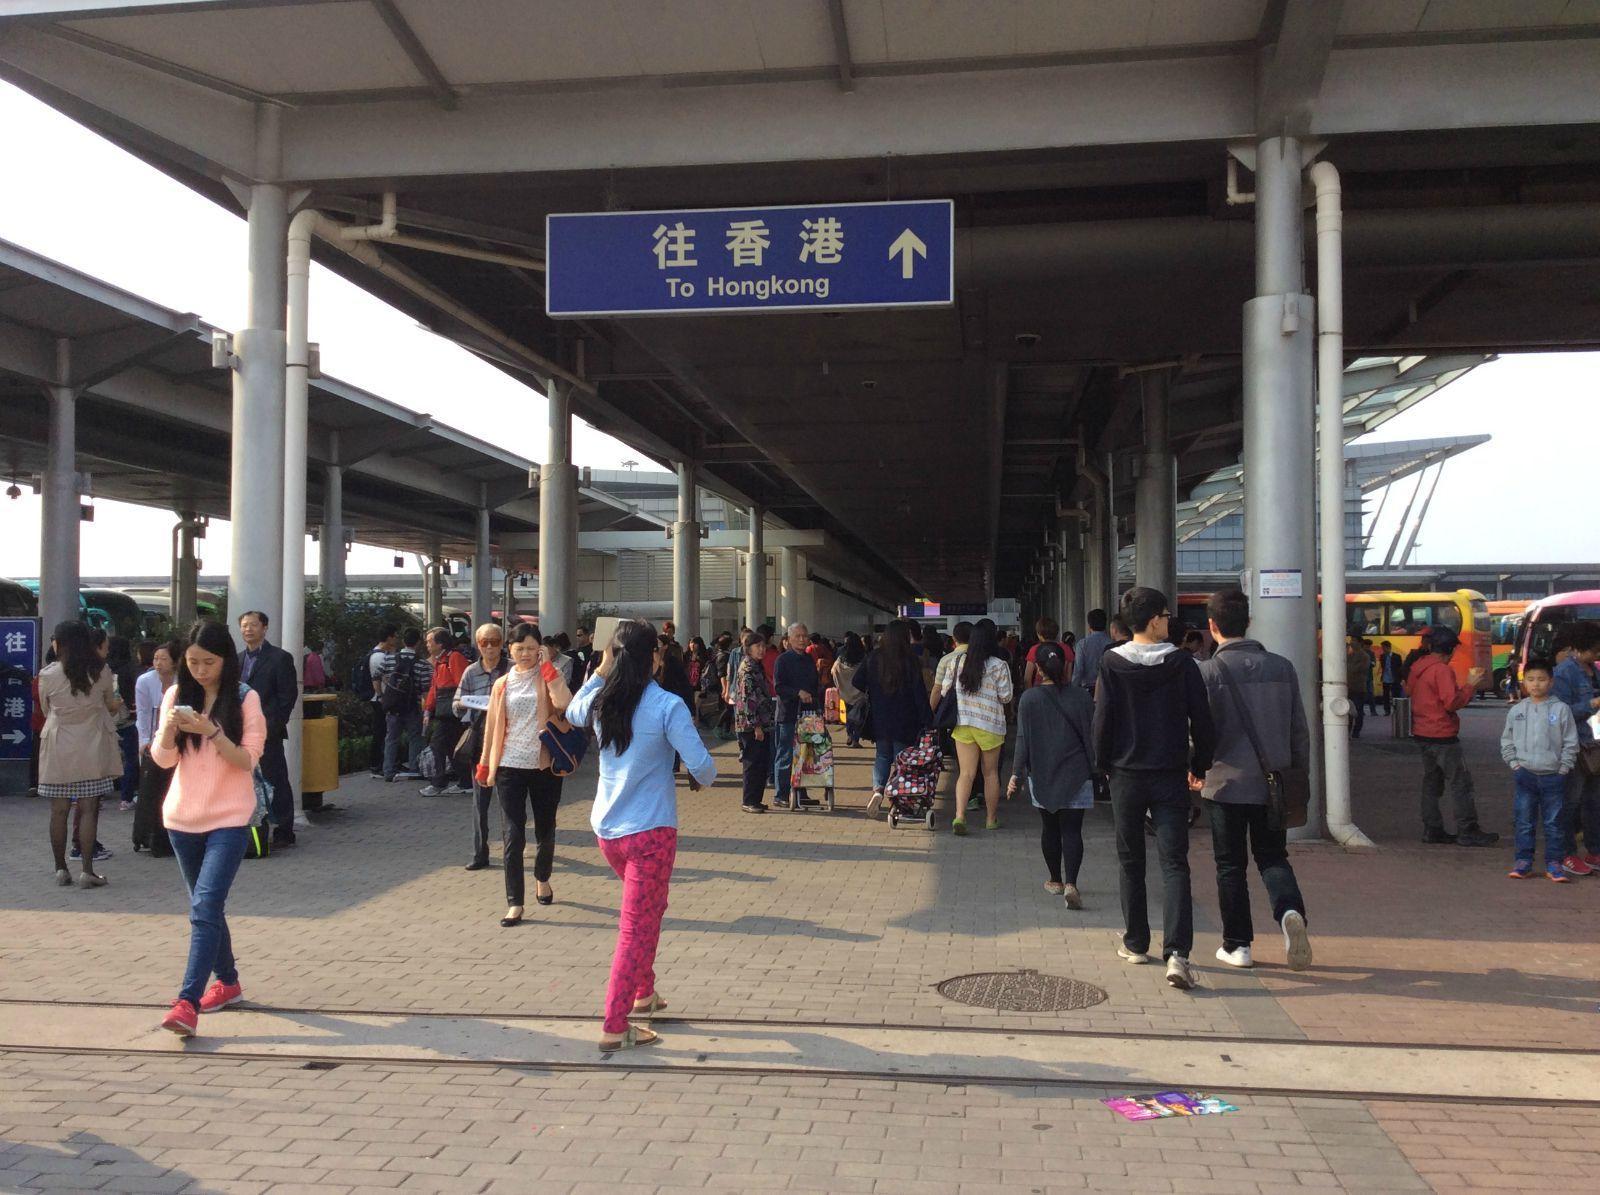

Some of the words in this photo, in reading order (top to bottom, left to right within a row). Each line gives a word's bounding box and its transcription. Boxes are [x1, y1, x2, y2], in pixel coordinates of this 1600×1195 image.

[651, 217, 844, 270] 往香港
[665, 278, 695, 298] To
[707, 274, 830, 301] Hongkong
